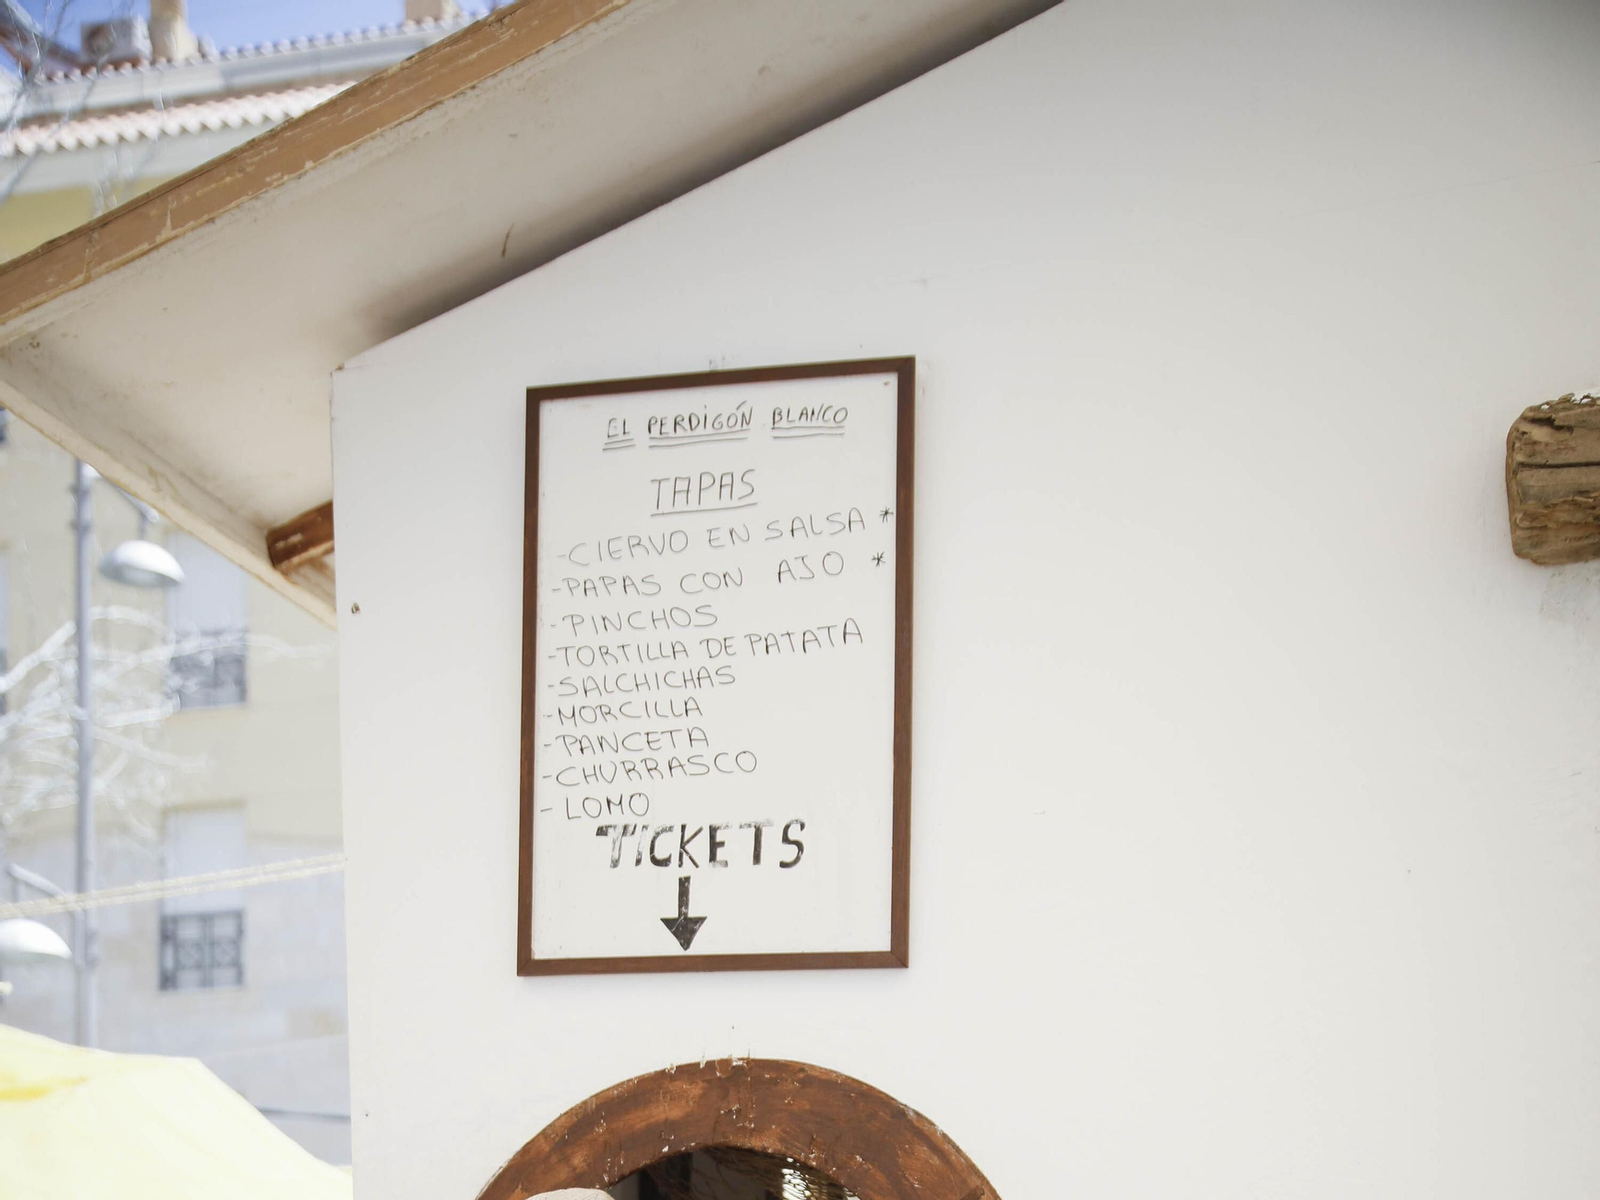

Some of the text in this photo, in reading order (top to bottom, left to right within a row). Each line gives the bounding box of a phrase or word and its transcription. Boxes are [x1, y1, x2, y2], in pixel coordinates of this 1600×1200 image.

[606, 400, 850, 440] EL PERDIGÓN BLANCO
[650, 468, 756, 510] TAPAS
[706, 523, 752, 548] EN
[764, 506, 866, 541] SALSA
[679, 566, 744, 595] CON
[699, 636, 738, 659] DE
[743, 617, 864, 657] PATATA
[595, 818, 806, 869] TICKETS
